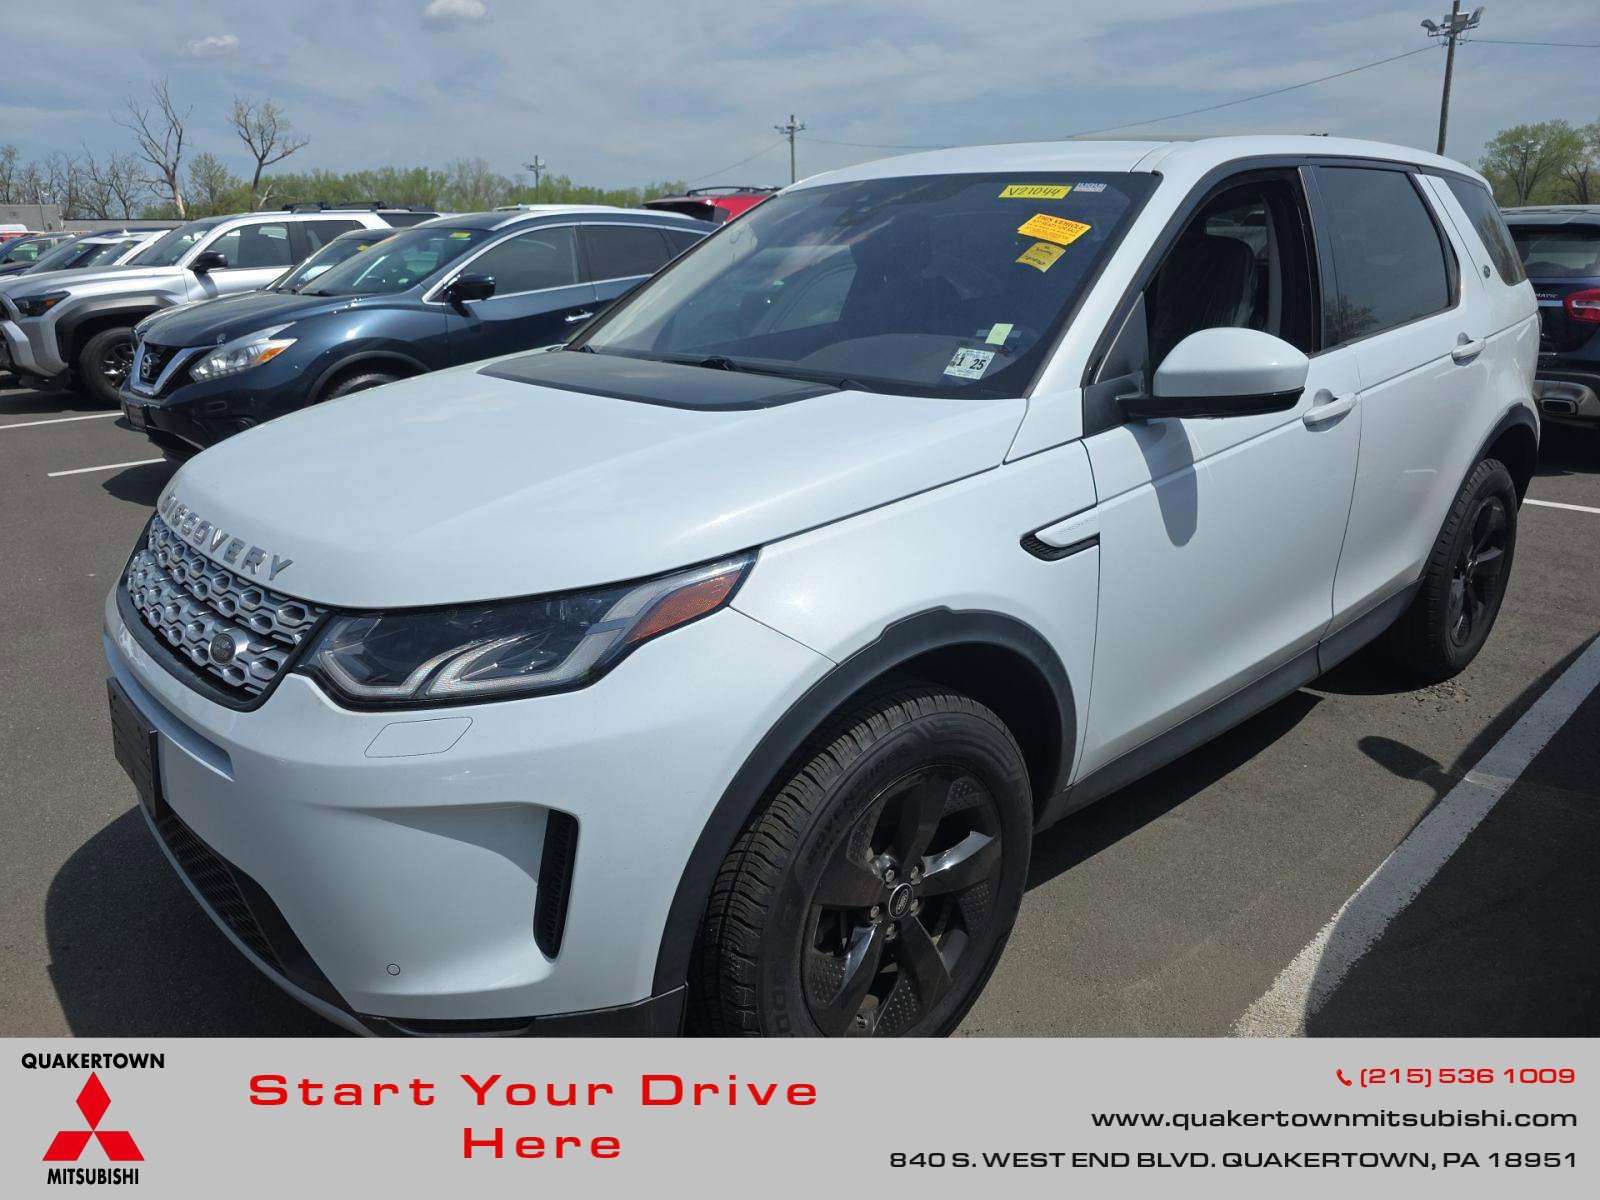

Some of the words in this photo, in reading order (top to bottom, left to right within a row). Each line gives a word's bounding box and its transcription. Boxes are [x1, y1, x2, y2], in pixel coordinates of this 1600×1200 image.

[1009, 186, 1060, 196] V21044
[970, 358, 986, 370] 25
[161, 491, 294, 581] DISCOVERY
